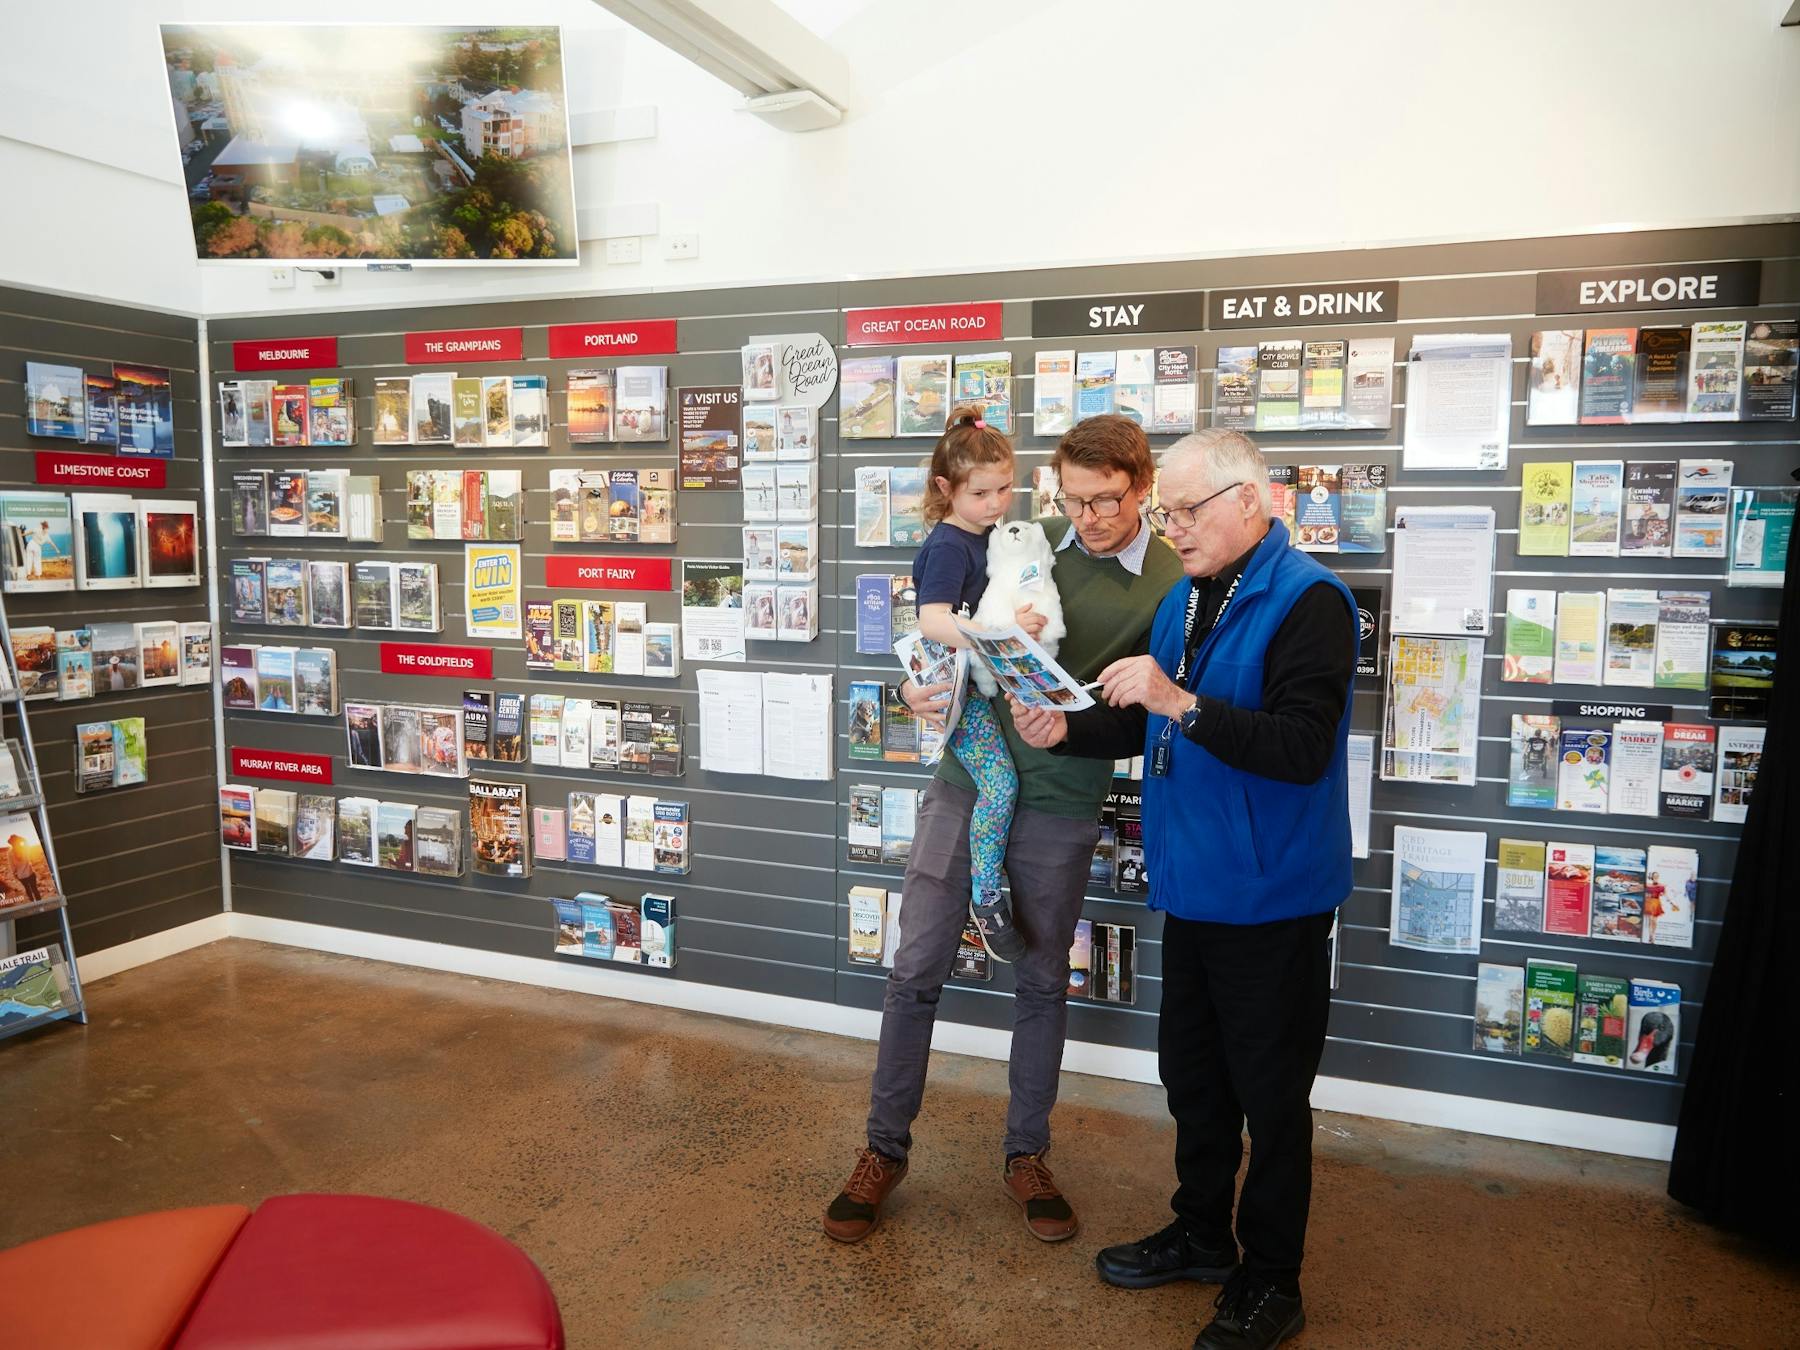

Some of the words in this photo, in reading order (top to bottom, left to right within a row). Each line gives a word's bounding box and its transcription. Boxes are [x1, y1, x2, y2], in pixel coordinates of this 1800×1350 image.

[1579, 275, 1718, 305] EXPLORE
[1222, 297, 1267, 319] EAT
[1273, 295, 1291, 316] &
[1299, 291, 1384, 316] DRINK
[1089, 304, 1144, 328] STAY
[862, 320, 900, 333] GREAT
[904, 318, 946, 332] OCEAN
[951, 316, 985, 329] ROAD
[585, 333, 638, 346] PORTLAND
[425, 343, 443, 352] THE
[446, 340, 501, 352] GRAMPIANS
[259, 349, 309, 361] MELBOURNE
[782, 340, 825, 367] Great
[789, 357, 833, 384] Ocean
[1158, 364, 1171, 372] City
[794, 367, 836, 397] Road
[694, 392, 721, 404] VISIT
[723, 392, 738, 403] US
[54, 464, 114, 477] LIMESTONE
[117, 466, 150, 478] COAST
[1628, 487, 1660, 496] Coming
[478, 559, 498, 568] ENTER
[498, 556, 508, 565] TO
[475, 565, 511, 588] WIN
[578, 567, 604, 578] PORT
[607, 569, 636, 580] FAIRY
[1226, 578, 1239, 597] AM
[529, 609, 552, 617] JAZZ
[397, 654, 415, 665] THE
[417, 656, 474, 668] GOLDFIELDS
[1357, 666, 1375, 674] 0399
[499, 706, 520, 715] CENTRE
[1579, 705, 1645, 718] SHOPPING
[465, 713, 487, 721] AURA
[1619, 735, 1657, 744] MARKET
[1673, 732, 1706, 741] DREAM
[240, 758, 273, 770] MURRAY
[274, 762, 299, 773] RIVER
[301, 764, 322, 775] AREA
[469, 784, 520, 798] BALLARAT
[1105, 794, 1119, 803] AY
[1666, 798, 1704, 807] MARKET
[1402, 834, 1425, 844] CBD
[1402, 843, 1451, 856] HERITAGE
[1402, 852, 1430, 863] TRAIL
[853, 912, 880, 920] DISCOVER
[0, 959, 18, 971] ALE
[20, 951, 47, 964] TRAIL
[1633, 987, 1653, 997] Birds
